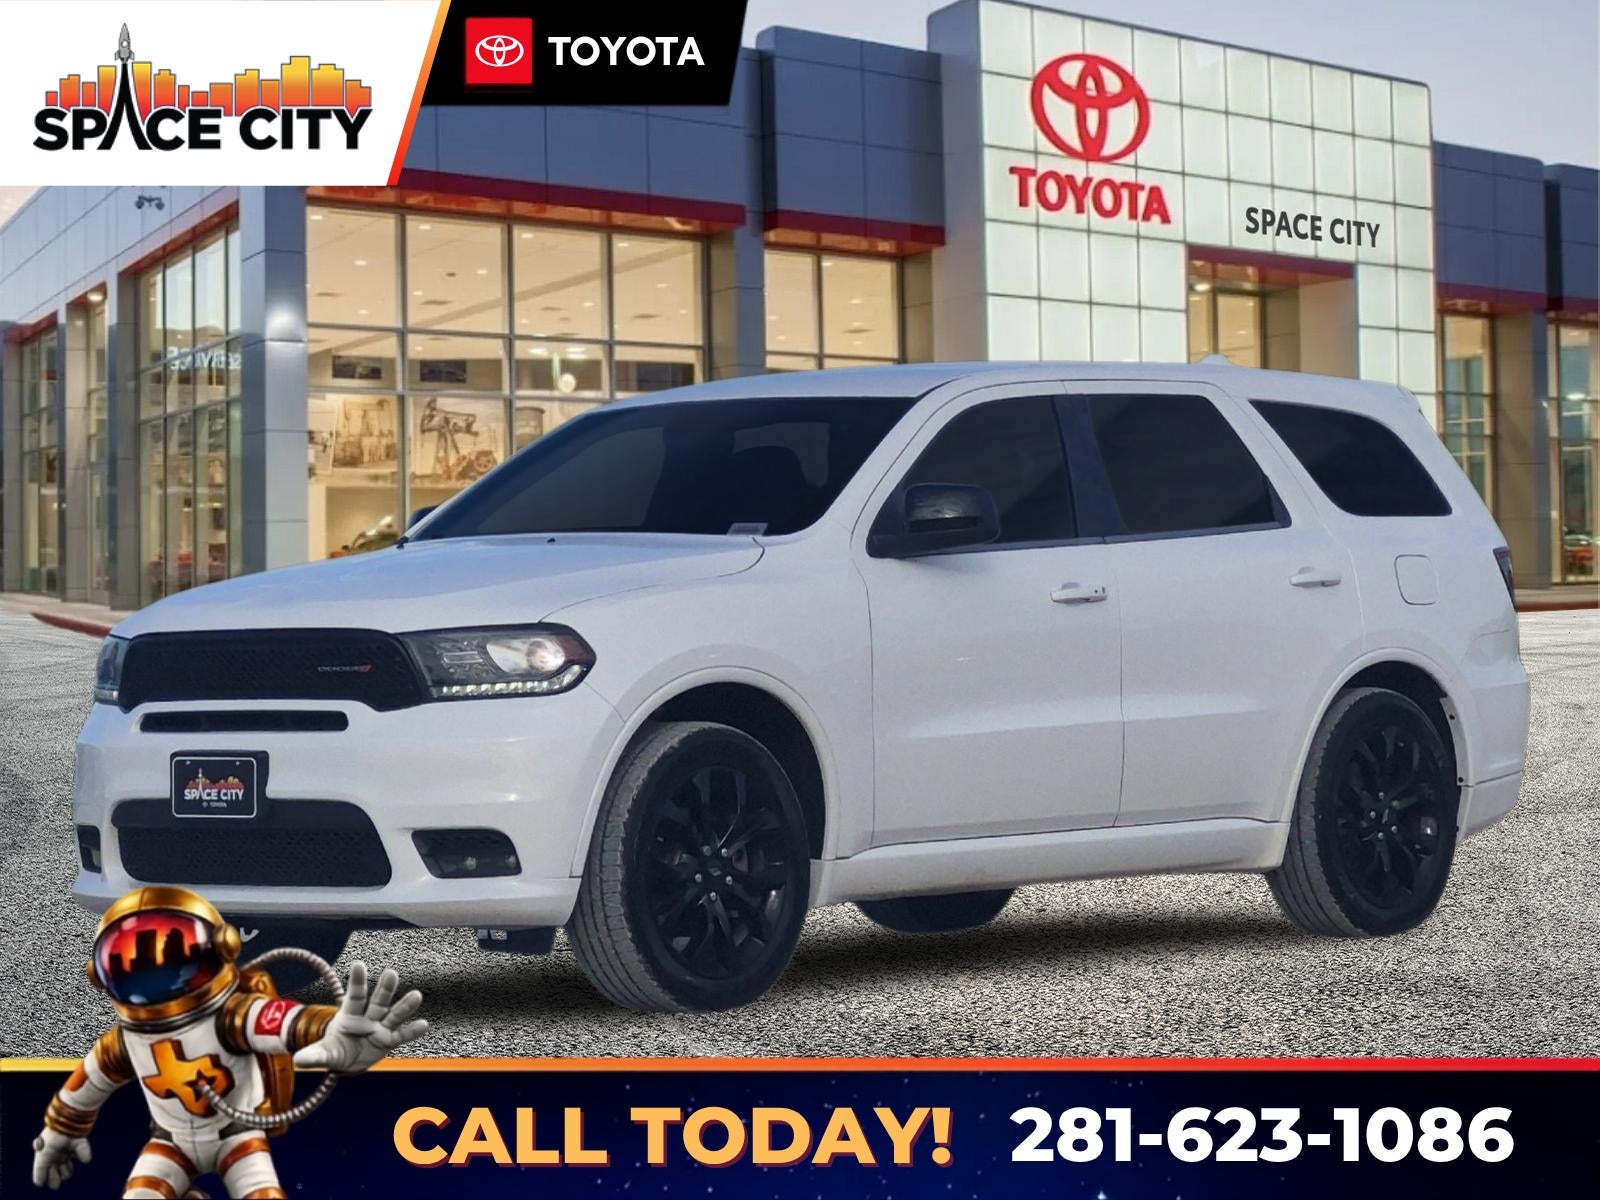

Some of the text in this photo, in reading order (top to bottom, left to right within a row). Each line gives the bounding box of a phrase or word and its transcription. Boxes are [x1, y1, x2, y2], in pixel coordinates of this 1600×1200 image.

[1009, 165, 1172, 225] TOYOTA
[1245, 206, 1381, 248] SPACE CITY
[184, 788, 244, 800] SPACE CITY
